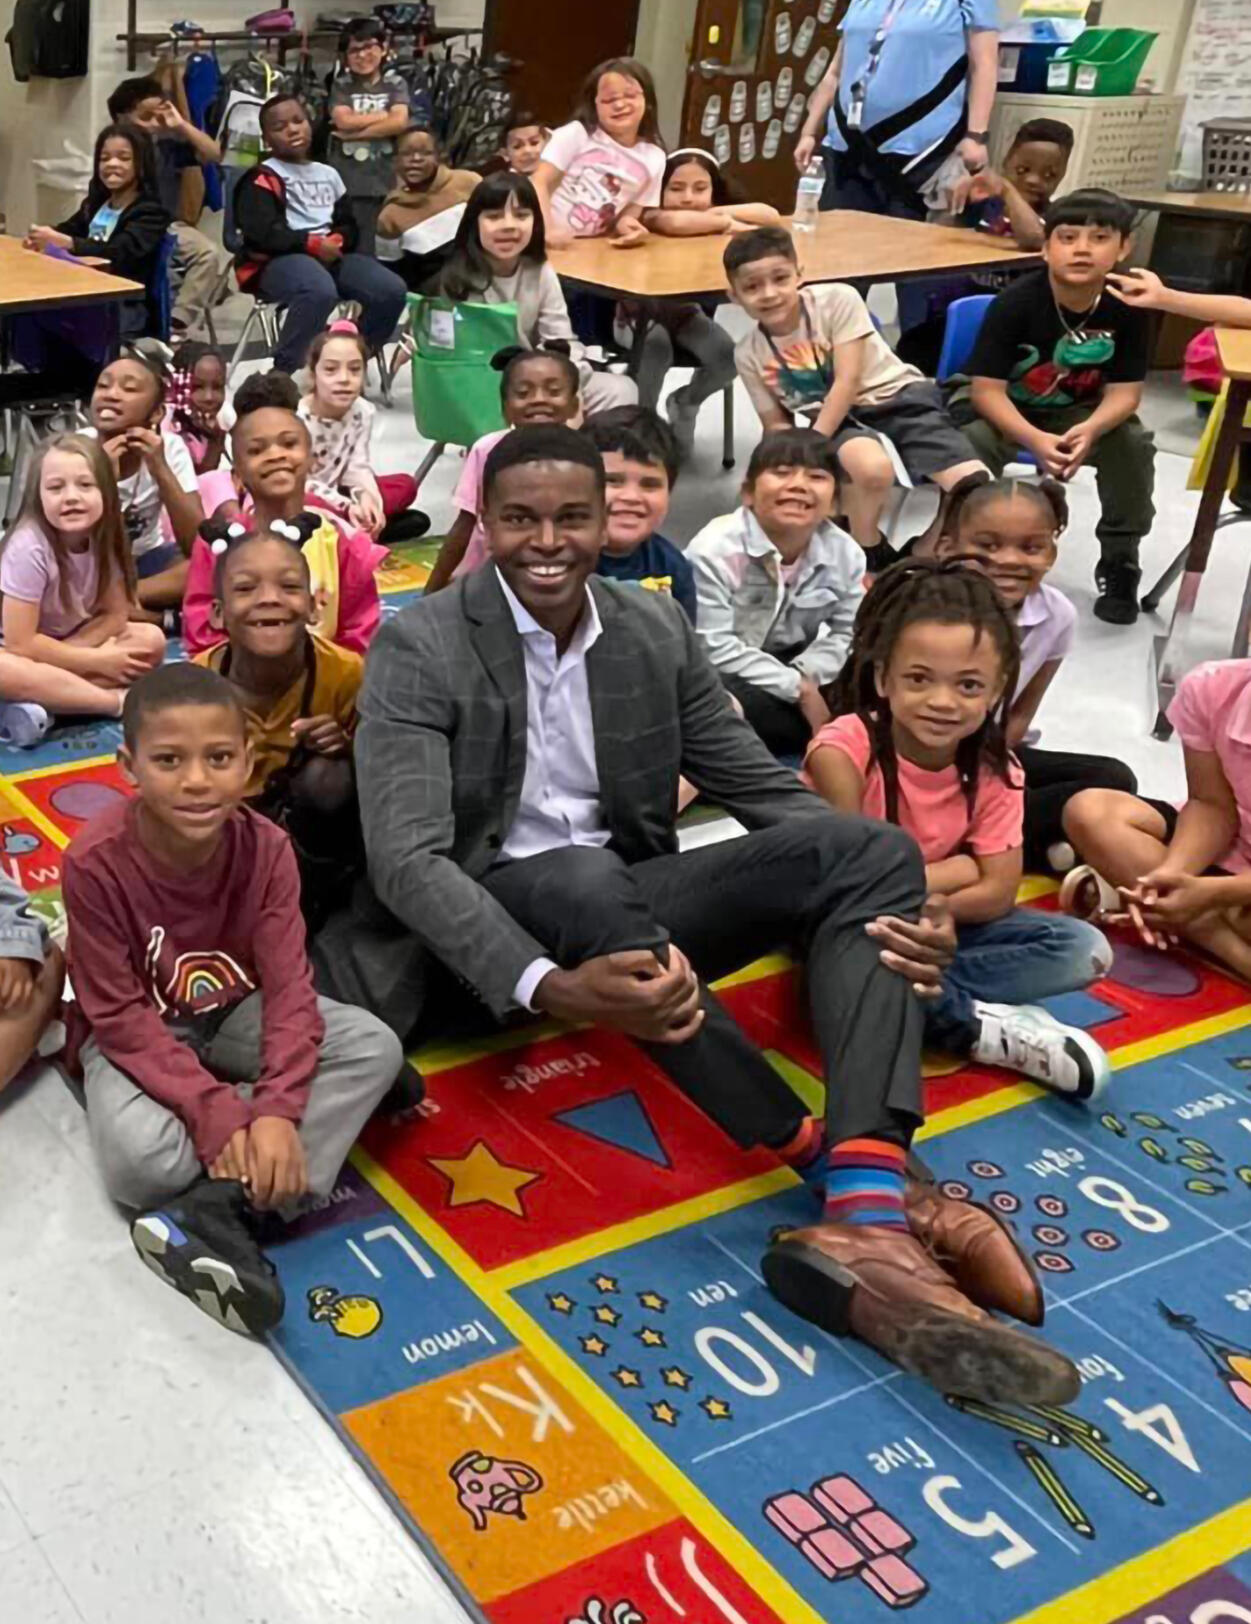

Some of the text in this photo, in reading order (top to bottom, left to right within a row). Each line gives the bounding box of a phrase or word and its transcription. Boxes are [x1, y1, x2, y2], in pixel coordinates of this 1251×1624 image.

[499, 1051, 601, 1094] triangle
[1171, 1092, 1236, 1120] seven
[1026, 1148, 1086, 1178] eight
[1077, 1175, 1170, 1233] 8
[687, 1279, 739, 1309] ten
[401, 1318, 498, 1364] lemon
[693, 1311, 819, 1397] 10
[1075, 1353, 1125, 1385] fou
[446, 1365, 575, 1442] Kk
[866, 1434, 936, 1476] five
[1103, 1396, 1201, 1473] 4
[552, 1476, 650, 1535] kettle
[922, 1474, 1038, 1570] 5
